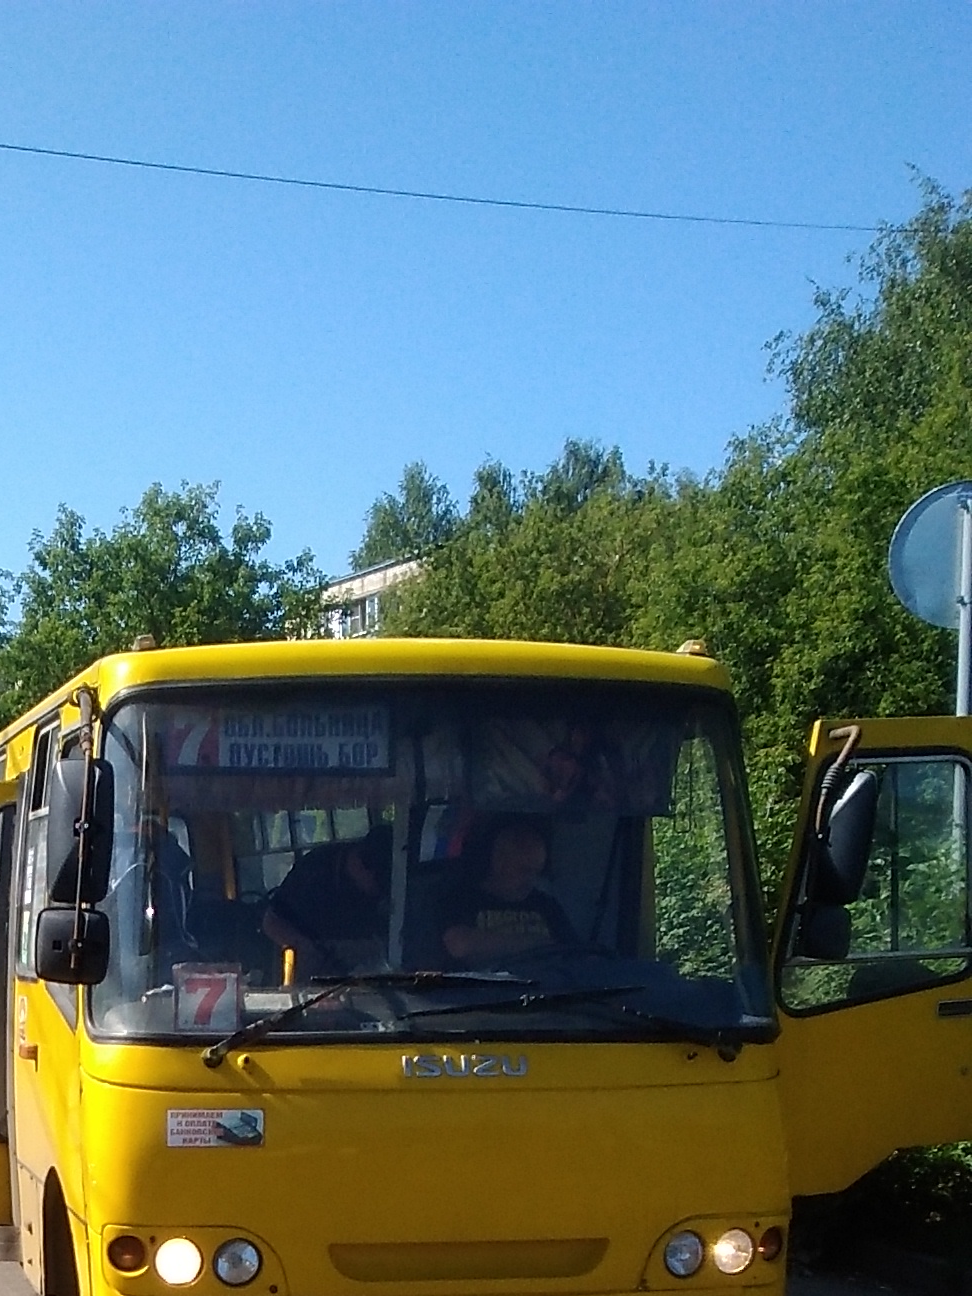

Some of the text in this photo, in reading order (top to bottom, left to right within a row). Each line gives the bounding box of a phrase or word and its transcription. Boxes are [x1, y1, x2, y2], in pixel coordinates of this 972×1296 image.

[174, 709, 212, 766] 7
[338, 742, 379, 767] БОР
[185, 977, 227, 1026] 7
[402, 1054, 528, 1077] ISUZU
[170, 1111, 224, 1119] ПРИНИМАЕМ
[170, 1128, 222, 1136] БАНКОВСК
[182, 1137, 211, 1145] КАРТЫ
